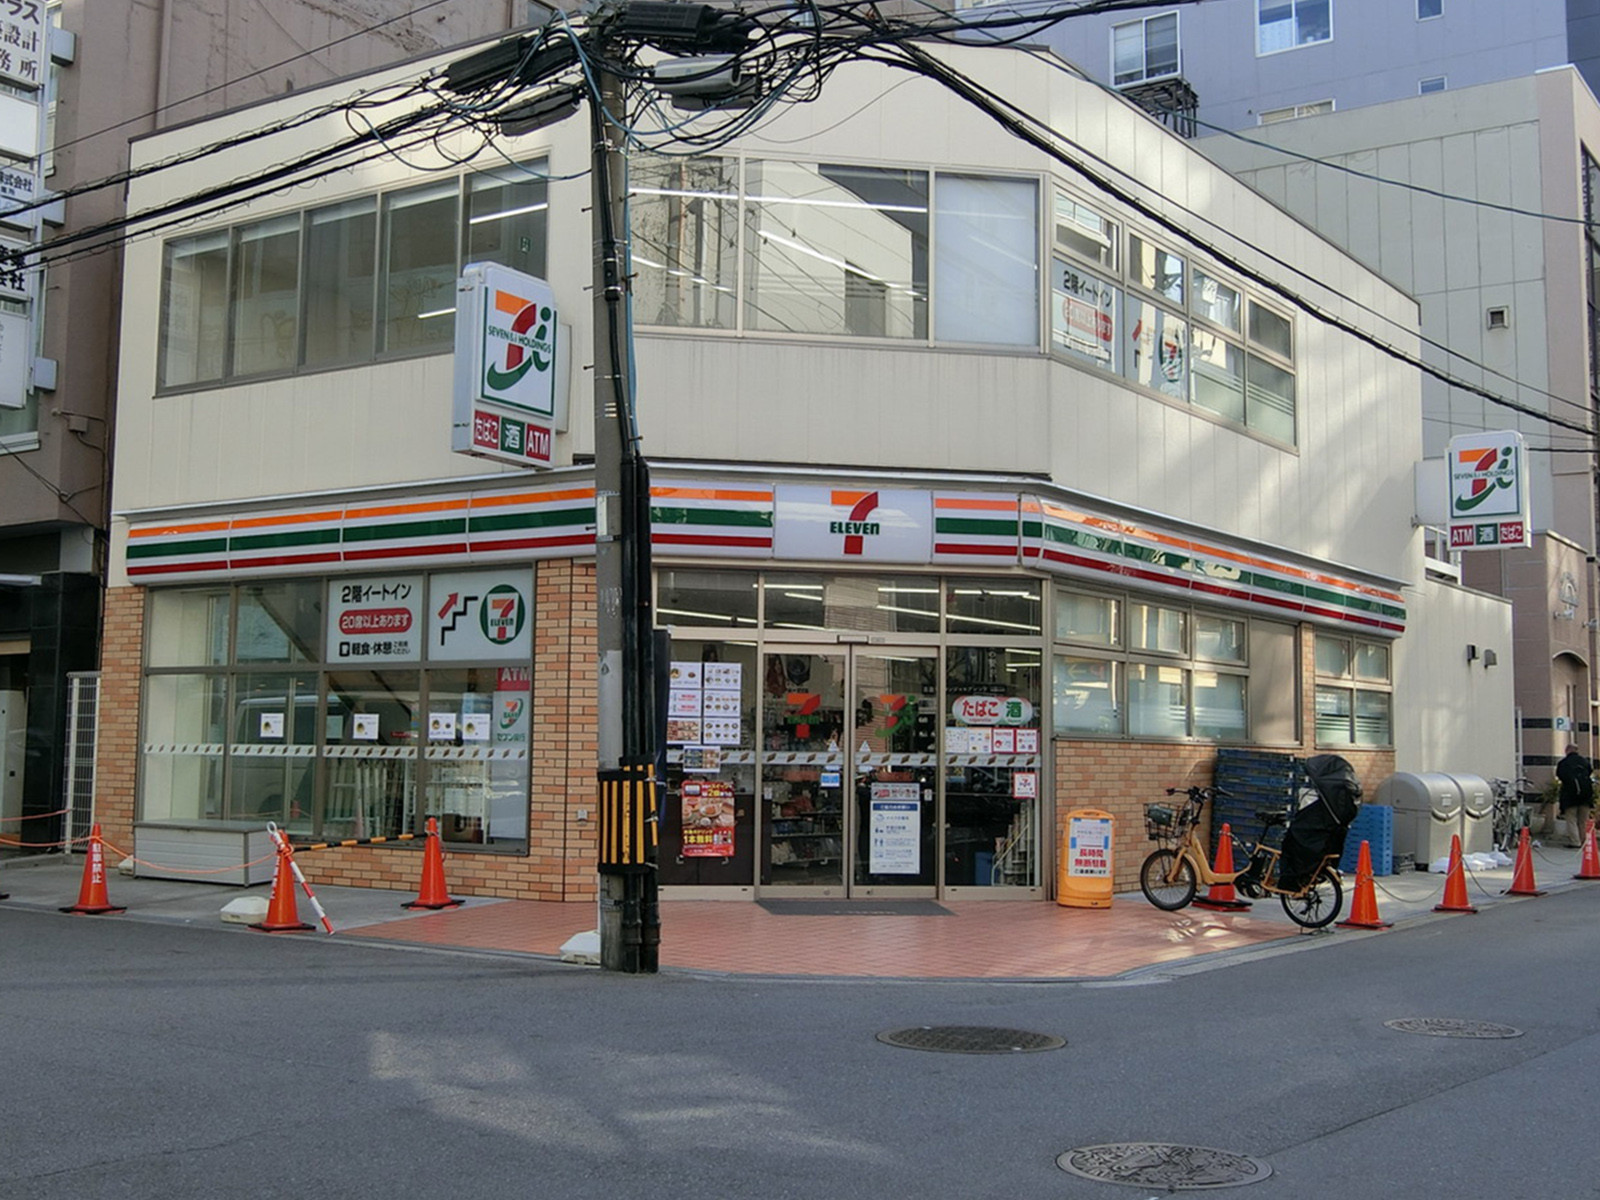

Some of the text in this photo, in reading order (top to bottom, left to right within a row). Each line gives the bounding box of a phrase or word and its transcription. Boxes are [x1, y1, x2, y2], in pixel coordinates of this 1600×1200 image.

[0, 22, 40, 53] 設計
[0, 171, 32, 192] 式会社
[475, 417, 499, 442] たばこ
[505, 423, 521, 449] 酒
[527, 430, 549, 456] ATM
[1452, 528, 1473, 544] ATM
[1479, 526, 1494, 543] 酒
[1500, 525, 1523, 541] たばこ
[342, 583, 412, 603] 2階イートイン
[501, 667, 530, 682] ATM
[962, 701, 999, 717] たばこ
[1006, 701, 1022, 718] 酒
[1557, 718, 1565, 729] P
